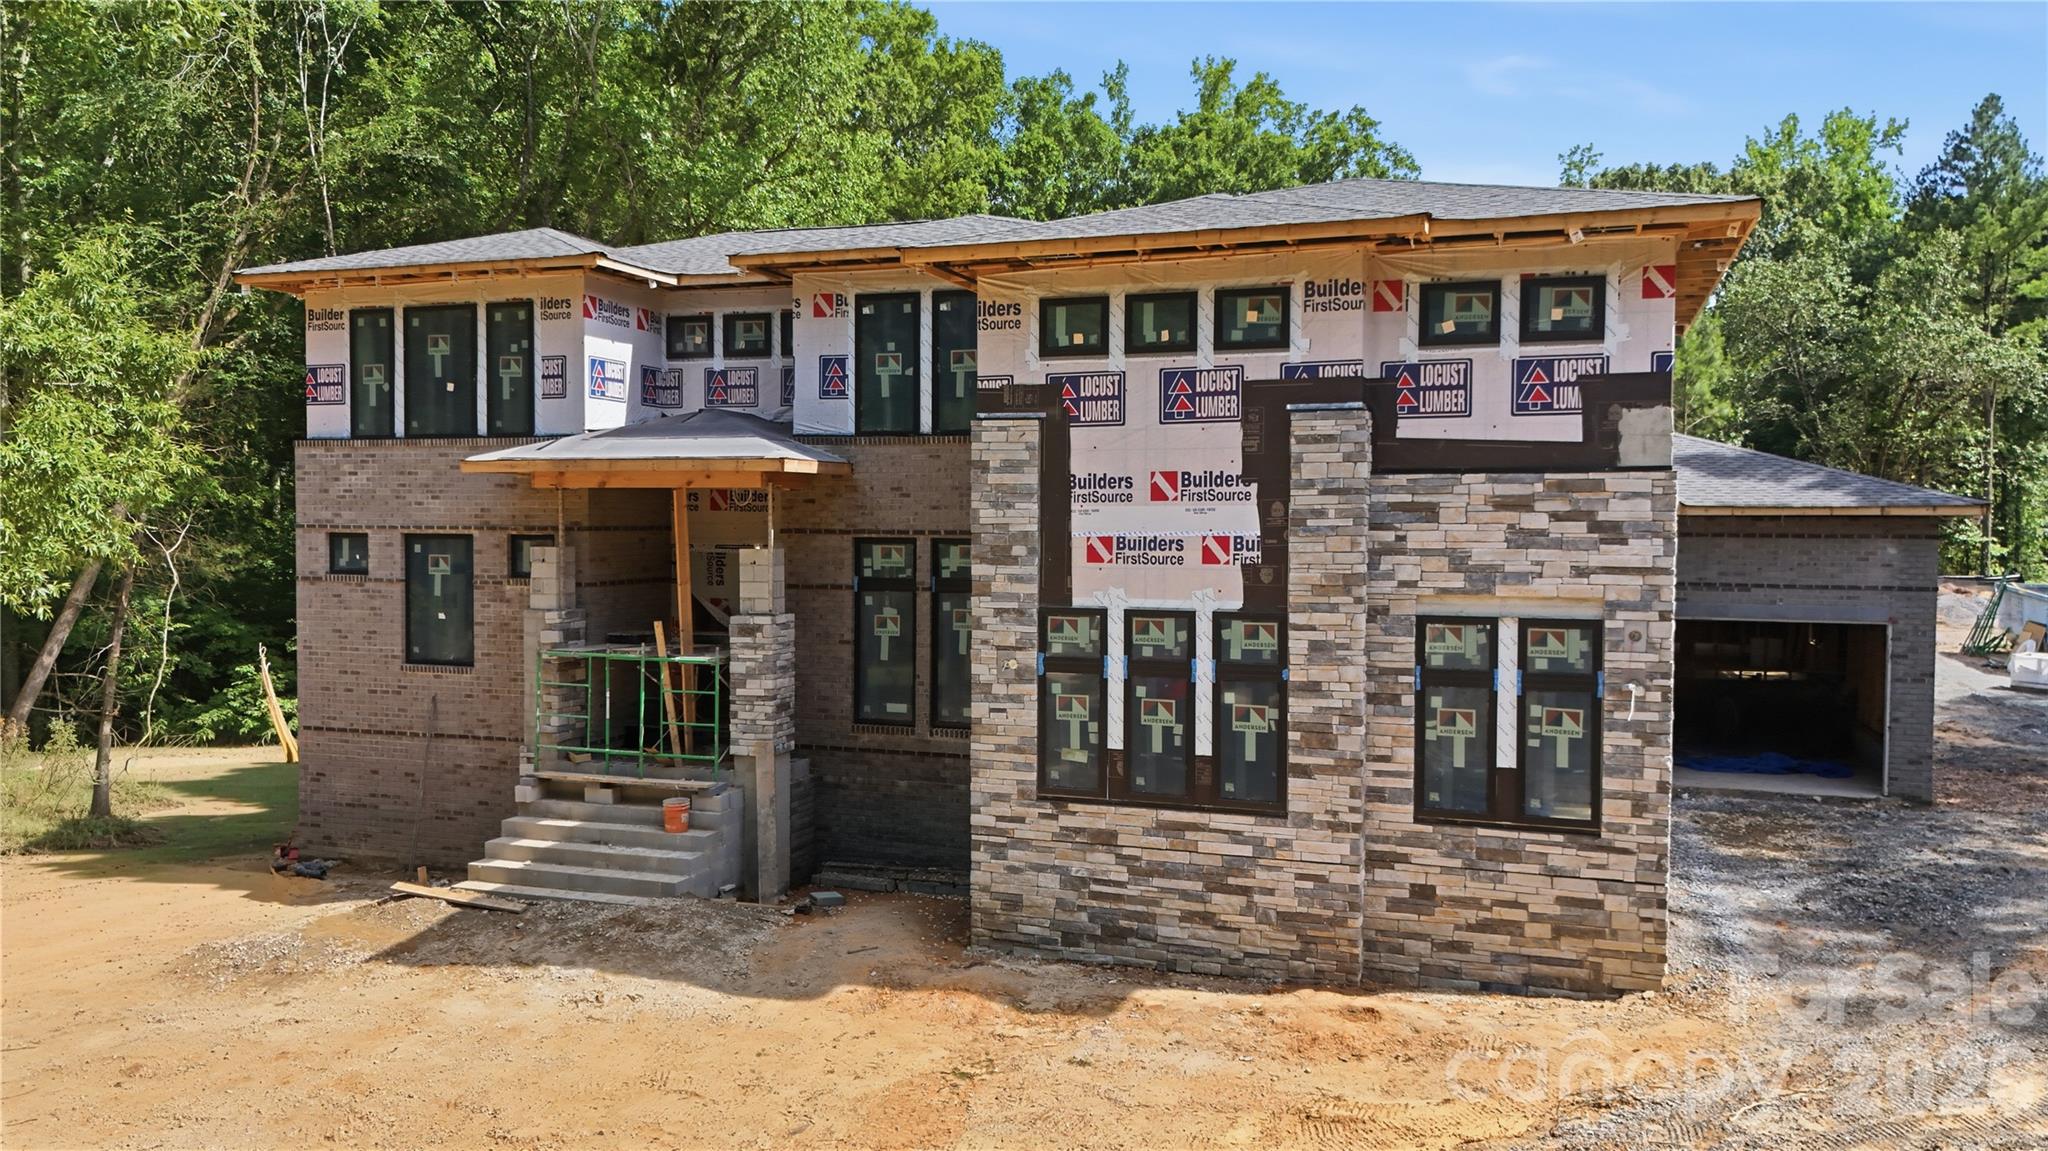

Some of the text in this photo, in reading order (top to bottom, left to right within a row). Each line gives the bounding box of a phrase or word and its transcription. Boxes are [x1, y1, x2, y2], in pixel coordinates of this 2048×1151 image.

[1304, 278, 1366, 298] Builder
[540, 297, 571, 309] ilders
[598, 299, 630, 318] Builders
[977, 300, 1021, 317] ilders
[308, 308, 344, 321] Builder
[597, 312, 630, 328] FirstSource
[308, 321, 345, 331] FirstSourc
[317, 367, 342, 383] LOCUST
[542, 359, 563, 375] CUST
[1420, 364, 1466, 386] LOCUST
[542, 378, 563, 394] MBER
[727, 370, 755, 386] LOCUST
[1080, 375, 1120, 397] LOCUST
[1196, 370, 1238, 392] LOCUST
[317, 385, 342, 401] LUMBER
[727, 387, 755, 404] LUMBER
[1419, 389, 1465, 413] LUMBER
[1553, 386, 1583, 410] LUM
[1080, 400, 1120, 422] LUMBER
[1196, 395, 1238, 418] LUMBER
[1180, 489, 1252, 502] FirstSource
[1115, 536, 1184, 552] Builders
[1115, 553, 1184, 566] FirstSource
[715, 552, 727, 586] ilders
